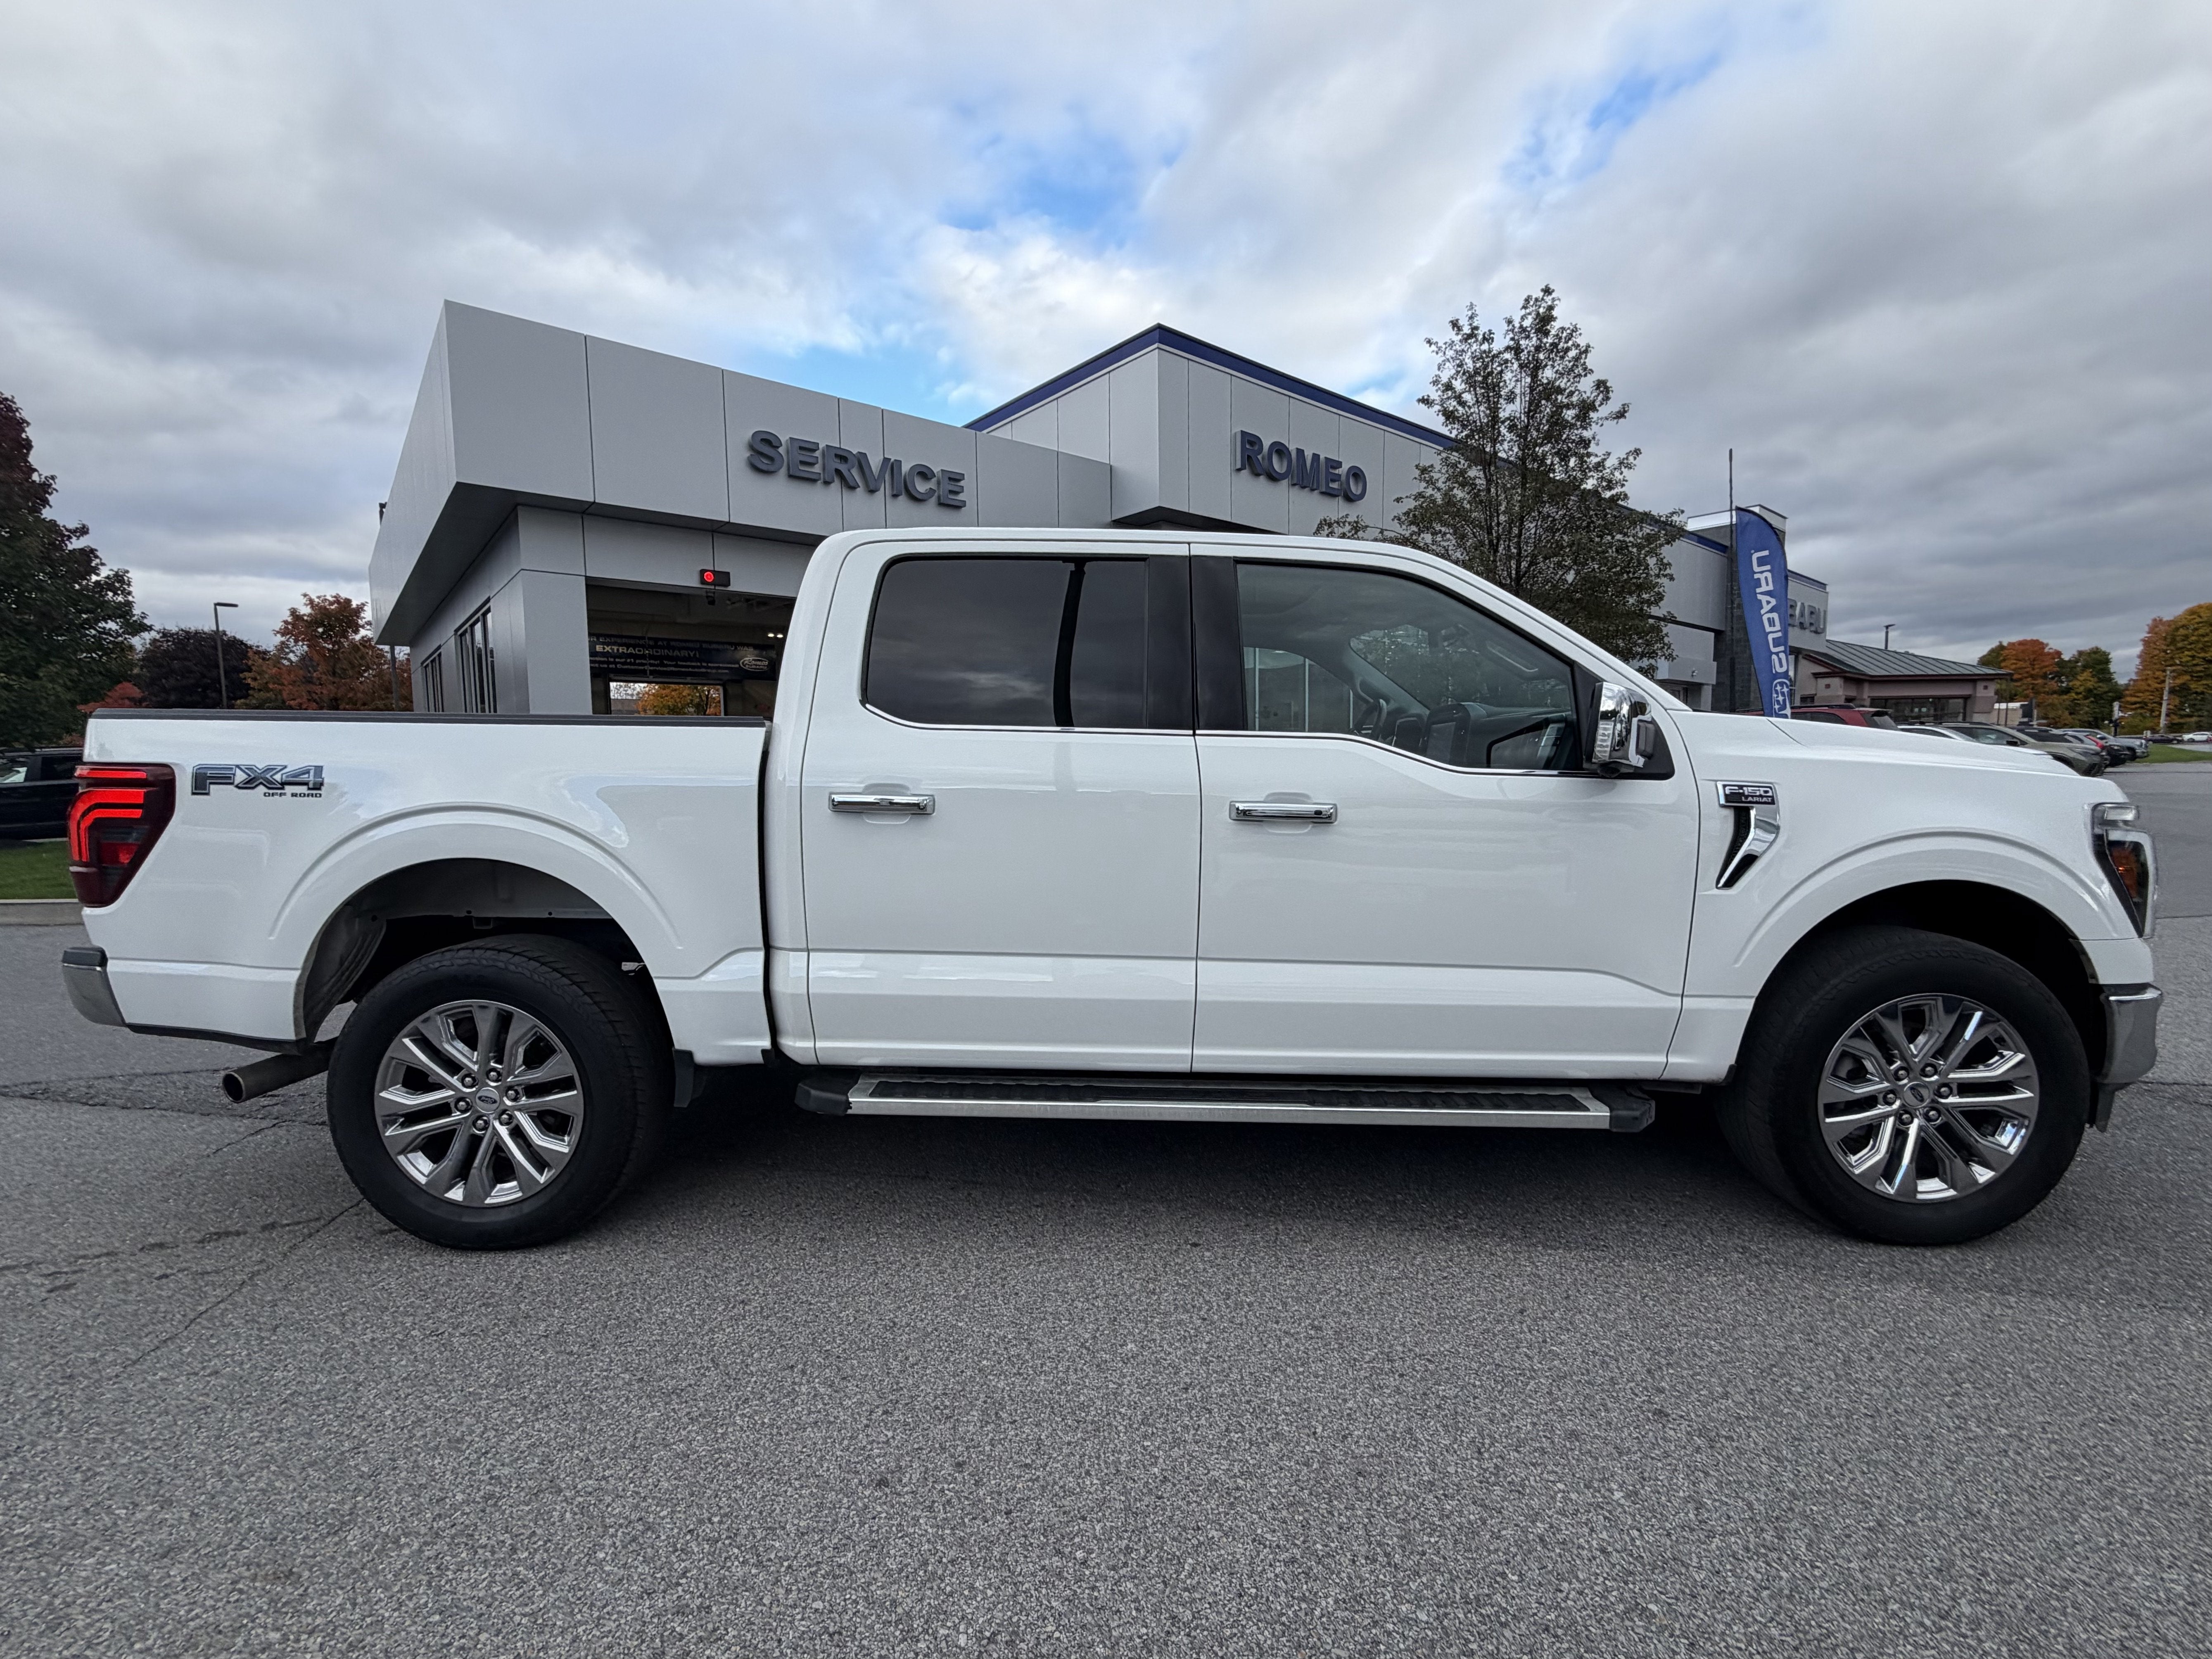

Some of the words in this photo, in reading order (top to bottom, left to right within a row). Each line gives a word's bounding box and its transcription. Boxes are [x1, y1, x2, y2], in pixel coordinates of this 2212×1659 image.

[748, 430, 966, 508] SERVICE
[1236, 430, 1367, 502] ROMEO
[1787, 598, 1827, 634] BARU
[596, 645, 700, 658] EXTRAORDINARY!
[191, 764, 324, 795] FX4
[1725, 786, 1773, 796] F-150
